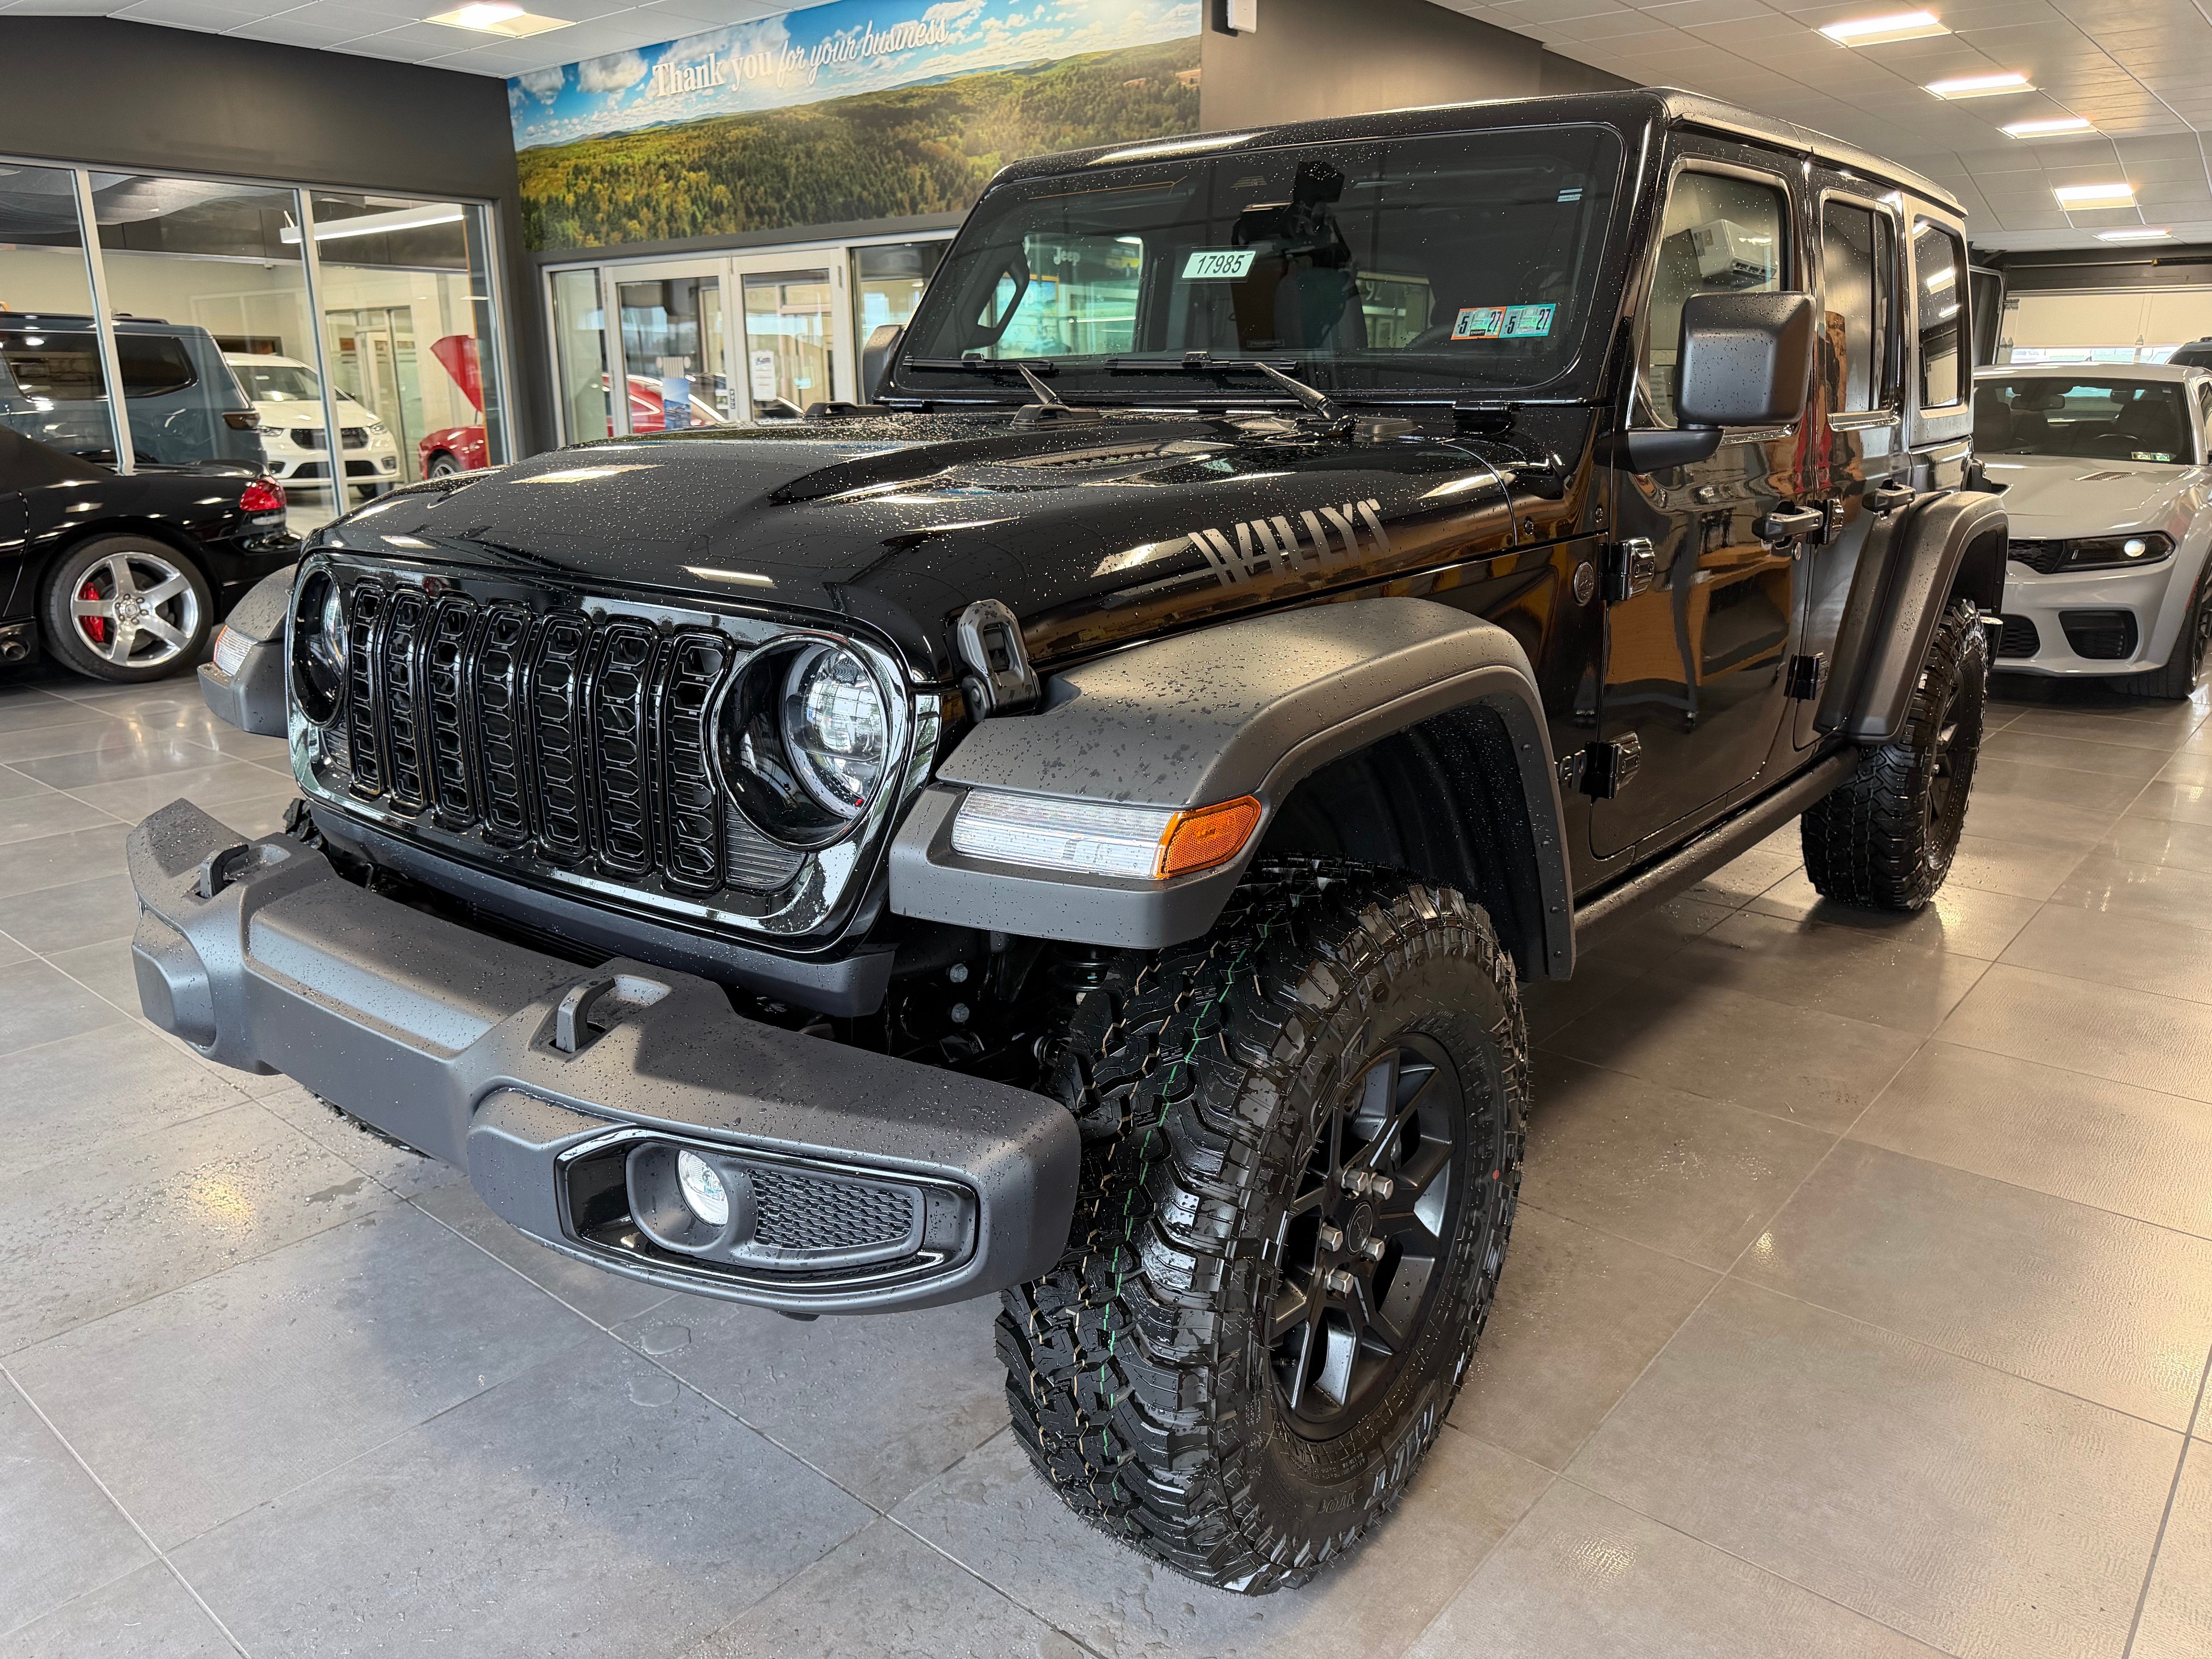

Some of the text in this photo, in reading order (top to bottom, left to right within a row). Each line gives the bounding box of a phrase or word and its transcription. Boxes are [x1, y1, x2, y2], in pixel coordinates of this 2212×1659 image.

[652, 17, 950, 98] Thank you for your business
[1053, 246, 1080, 266] Jeep
[1197, 255, 1245, 274] 17985
[1458, 311, 1502, 334] 5 27
[1506, 309, 1551, 334] 5 27
[1188, 498, 1391, 587] WILLYS
